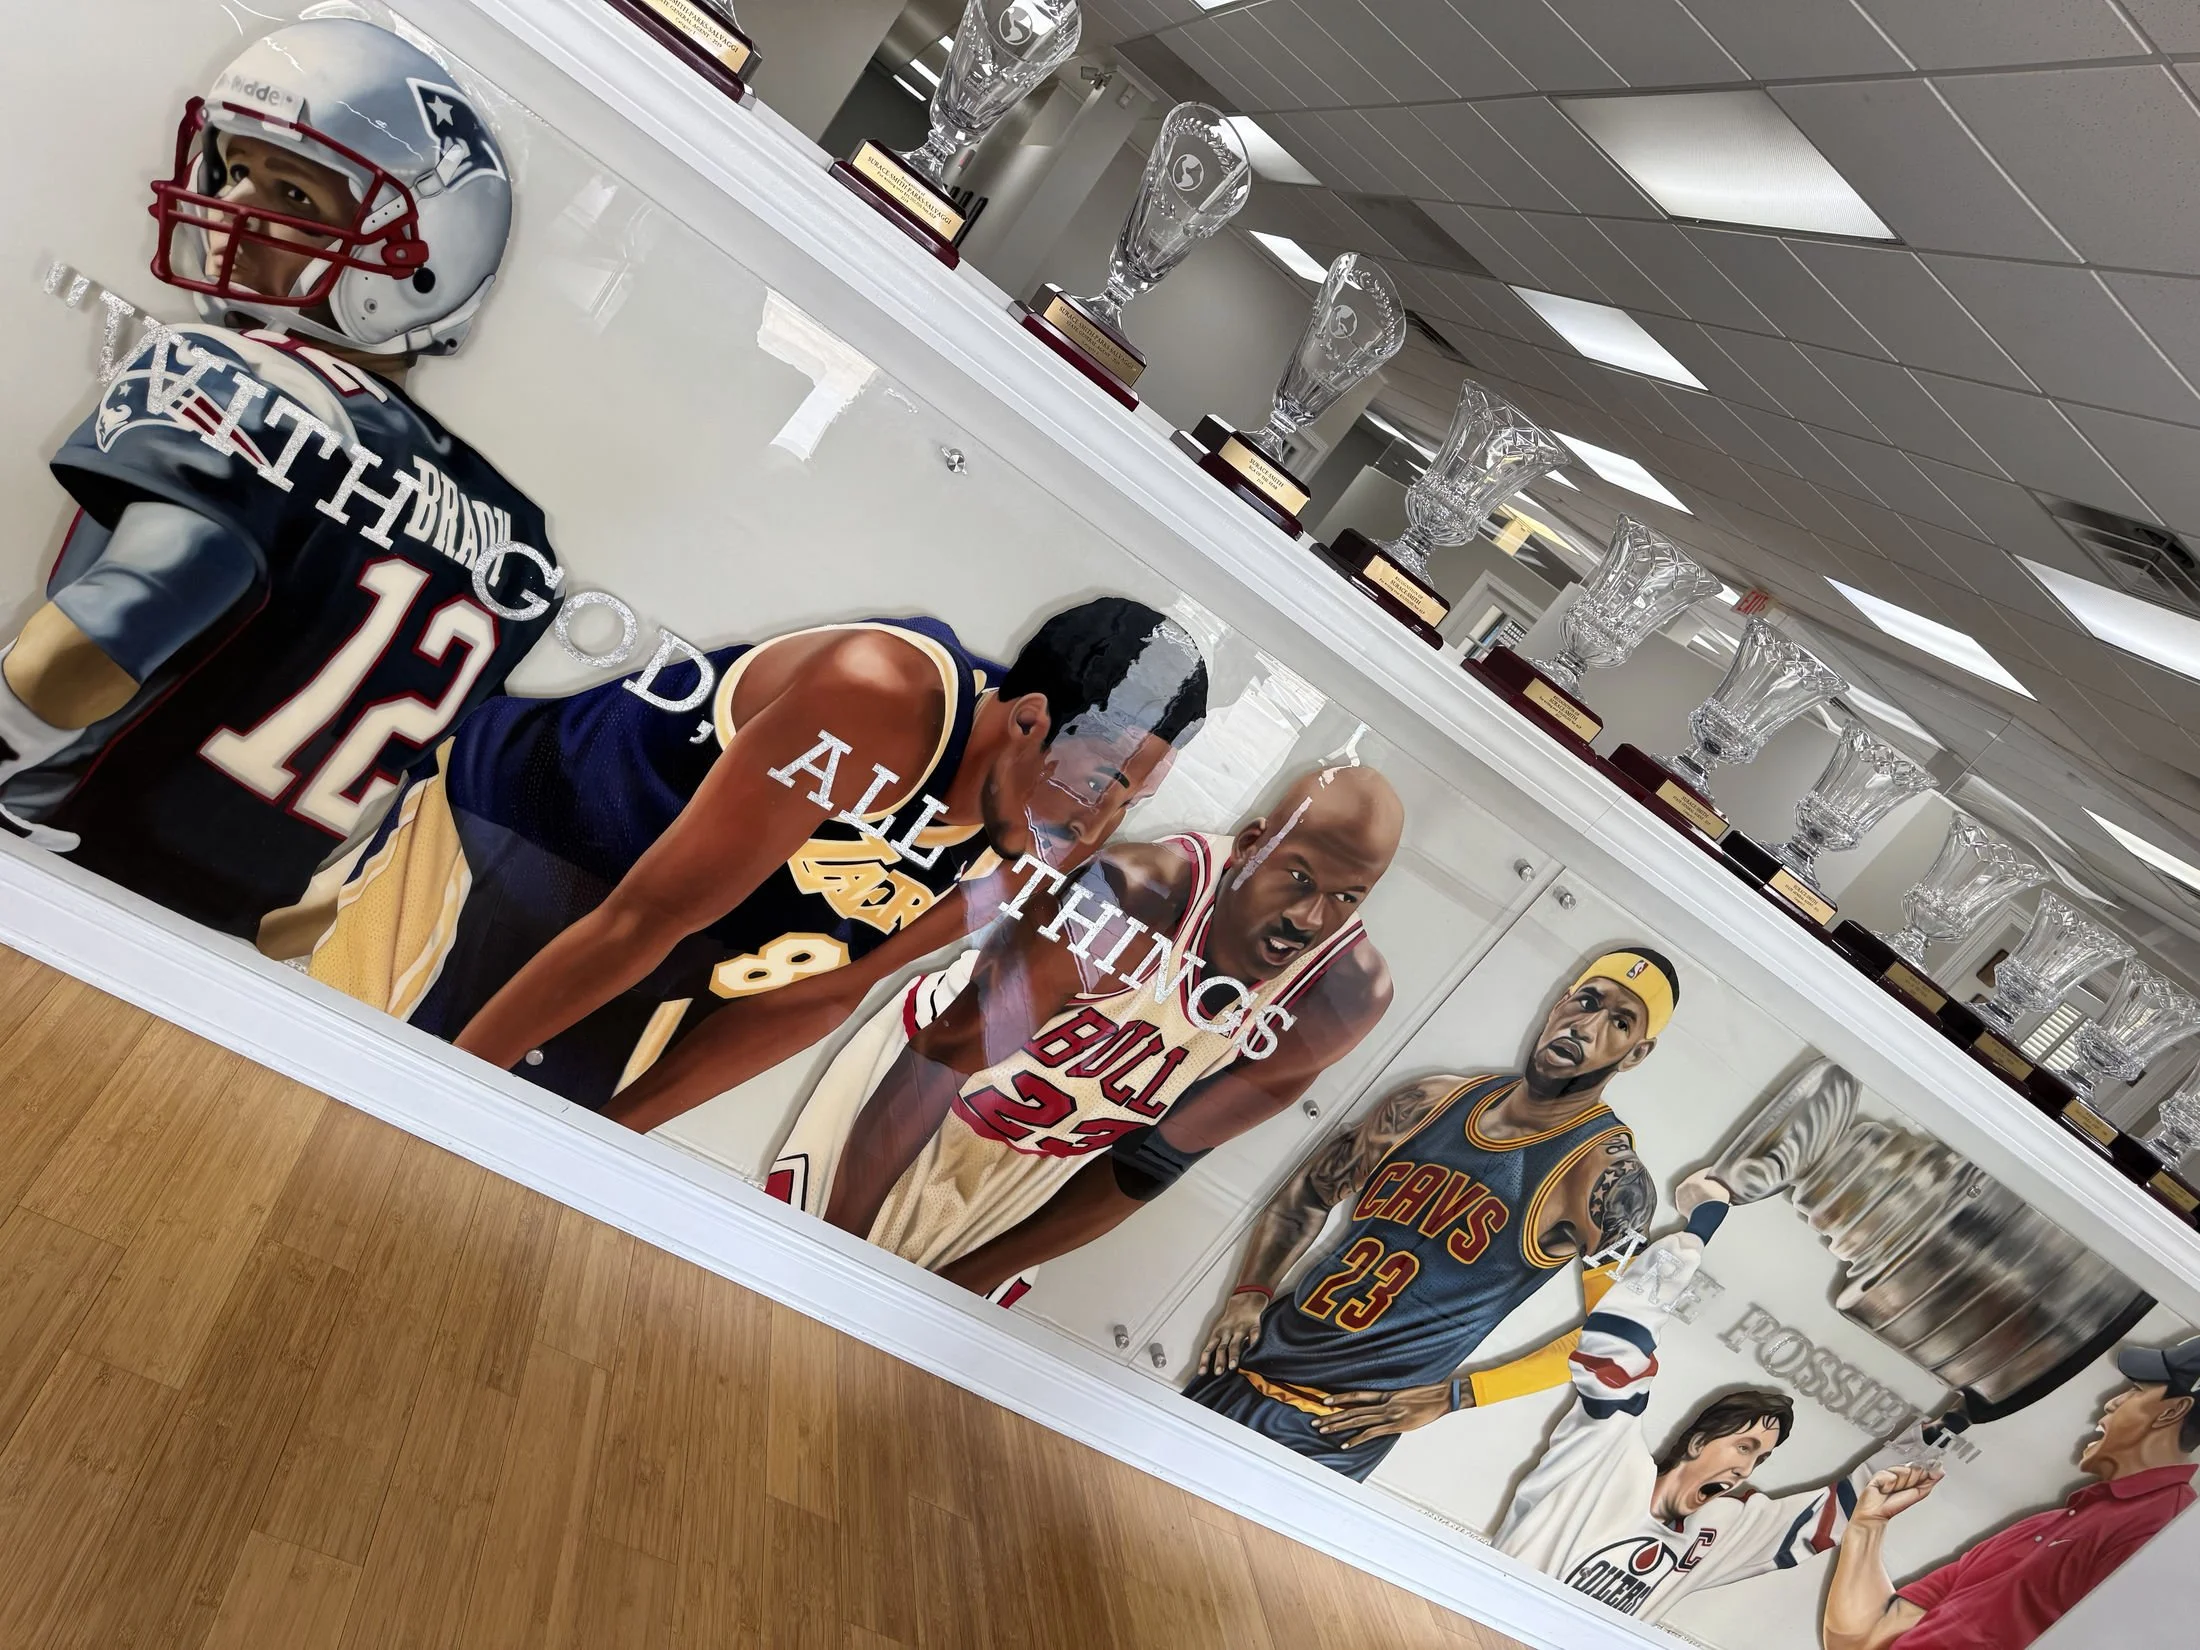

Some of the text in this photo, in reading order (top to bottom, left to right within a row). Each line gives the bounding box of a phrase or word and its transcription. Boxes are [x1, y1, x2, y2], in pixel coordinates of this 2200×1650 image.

[669, 5, 692, 24] GENERAL
[692, 23, 709, 38] AGENT
[197, 554, 501, 841] 12
[709, 932, 852, 999] 8
[766, 728, 950, 871] ALL
[997, 851, 1298, 1061] THINGS
[1582, 1227, 1727, 1326] ARE
[963, 1069, 1154, 1153] 23
[1353, 1161, 1510, 1265] CAVS
[1300, 1236, 1421, 1333] 23
[1571, 1559, 1652, 1617] OILERS
[1674, 1528, 1718, 1574] C
